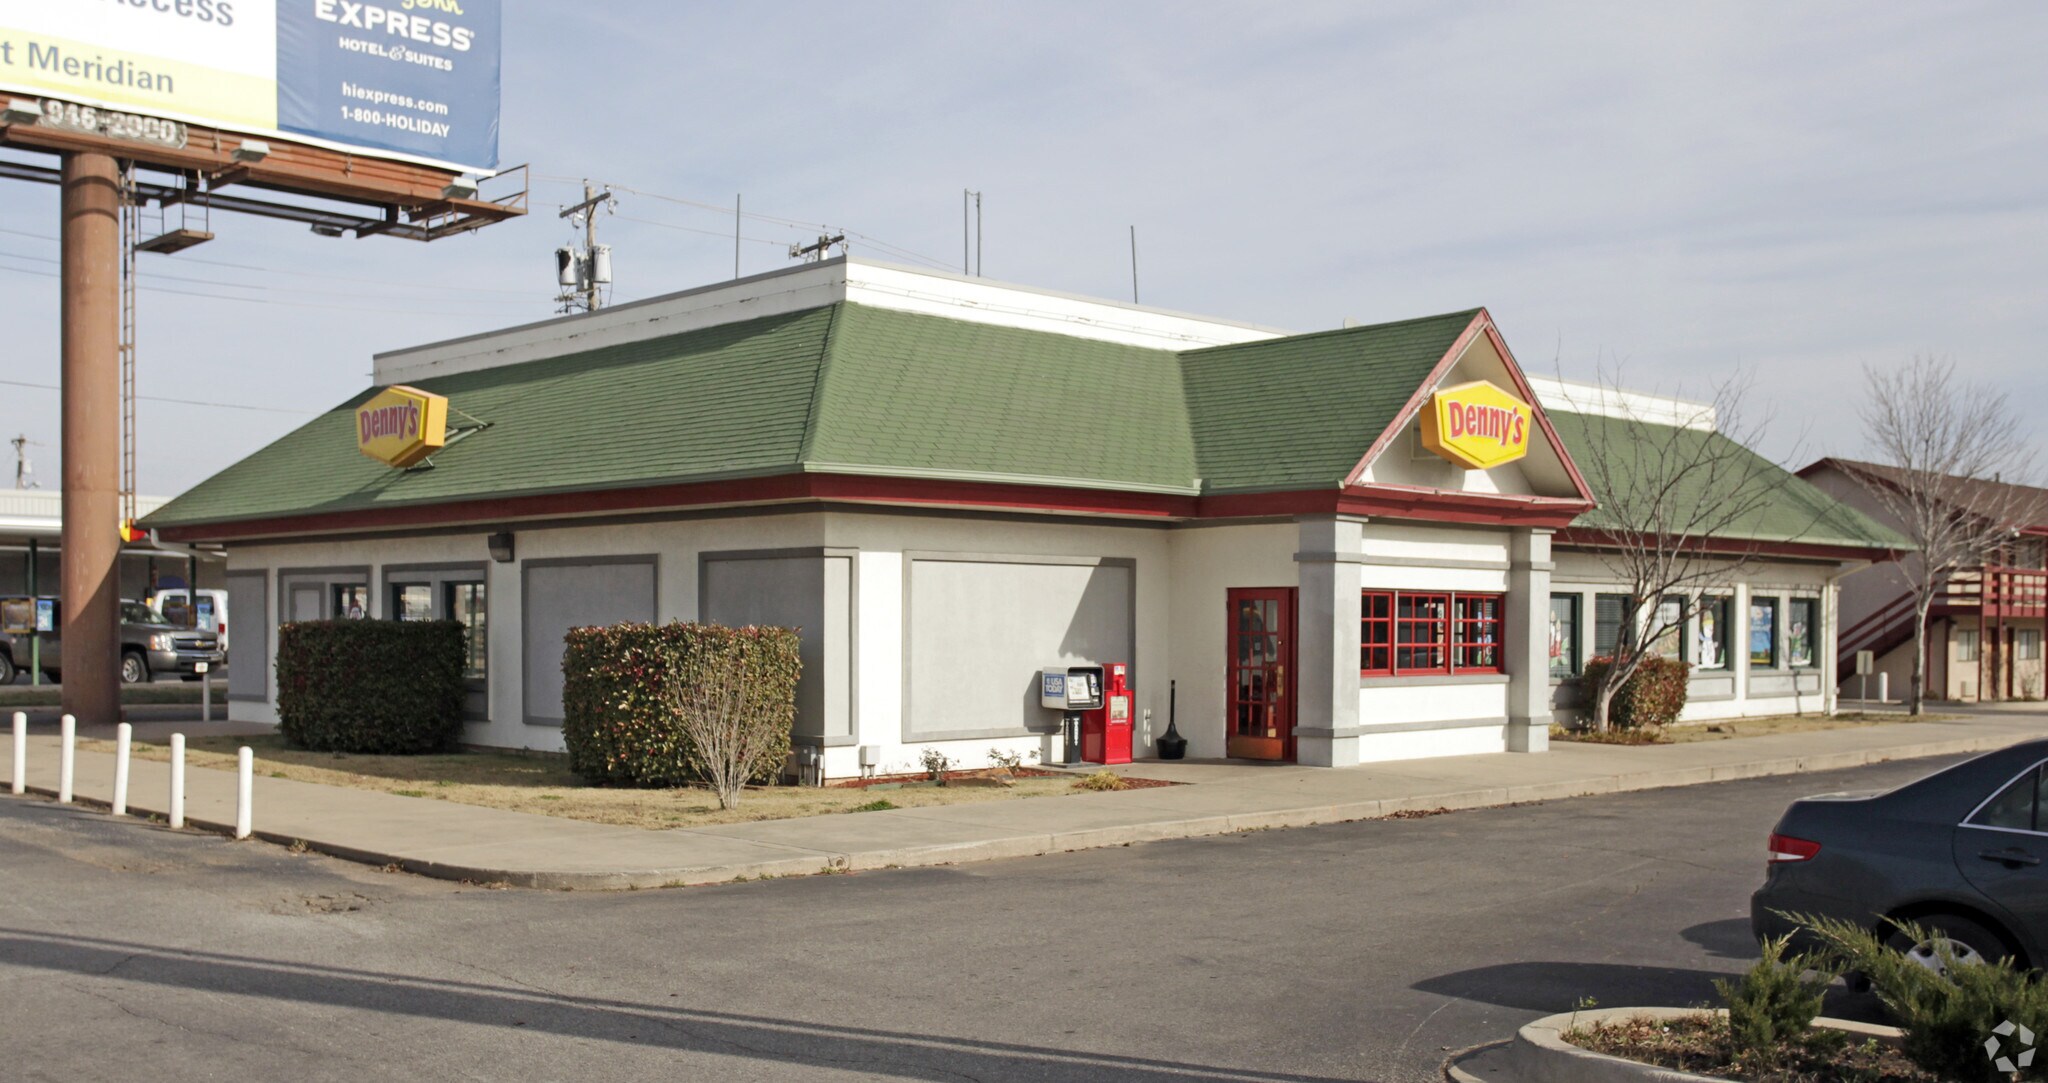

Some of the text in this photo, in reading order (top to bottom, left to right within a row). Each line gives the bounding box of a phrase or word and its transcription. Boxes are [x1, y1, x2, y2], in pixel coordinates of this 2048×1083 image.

[314, 0, 471, 51] EXPRESS
[28, 41, 174, 93] Meridian
[339, 37, 453, 71] HOTEL & SUITES
[342, 81, 448, 115] hiexpress.com
[341, 105, 450, 138] 1-800-HOLIDAY
[360, 399, 418, 445] Denny's
[1447, 401, 1525, 447] Denny's
